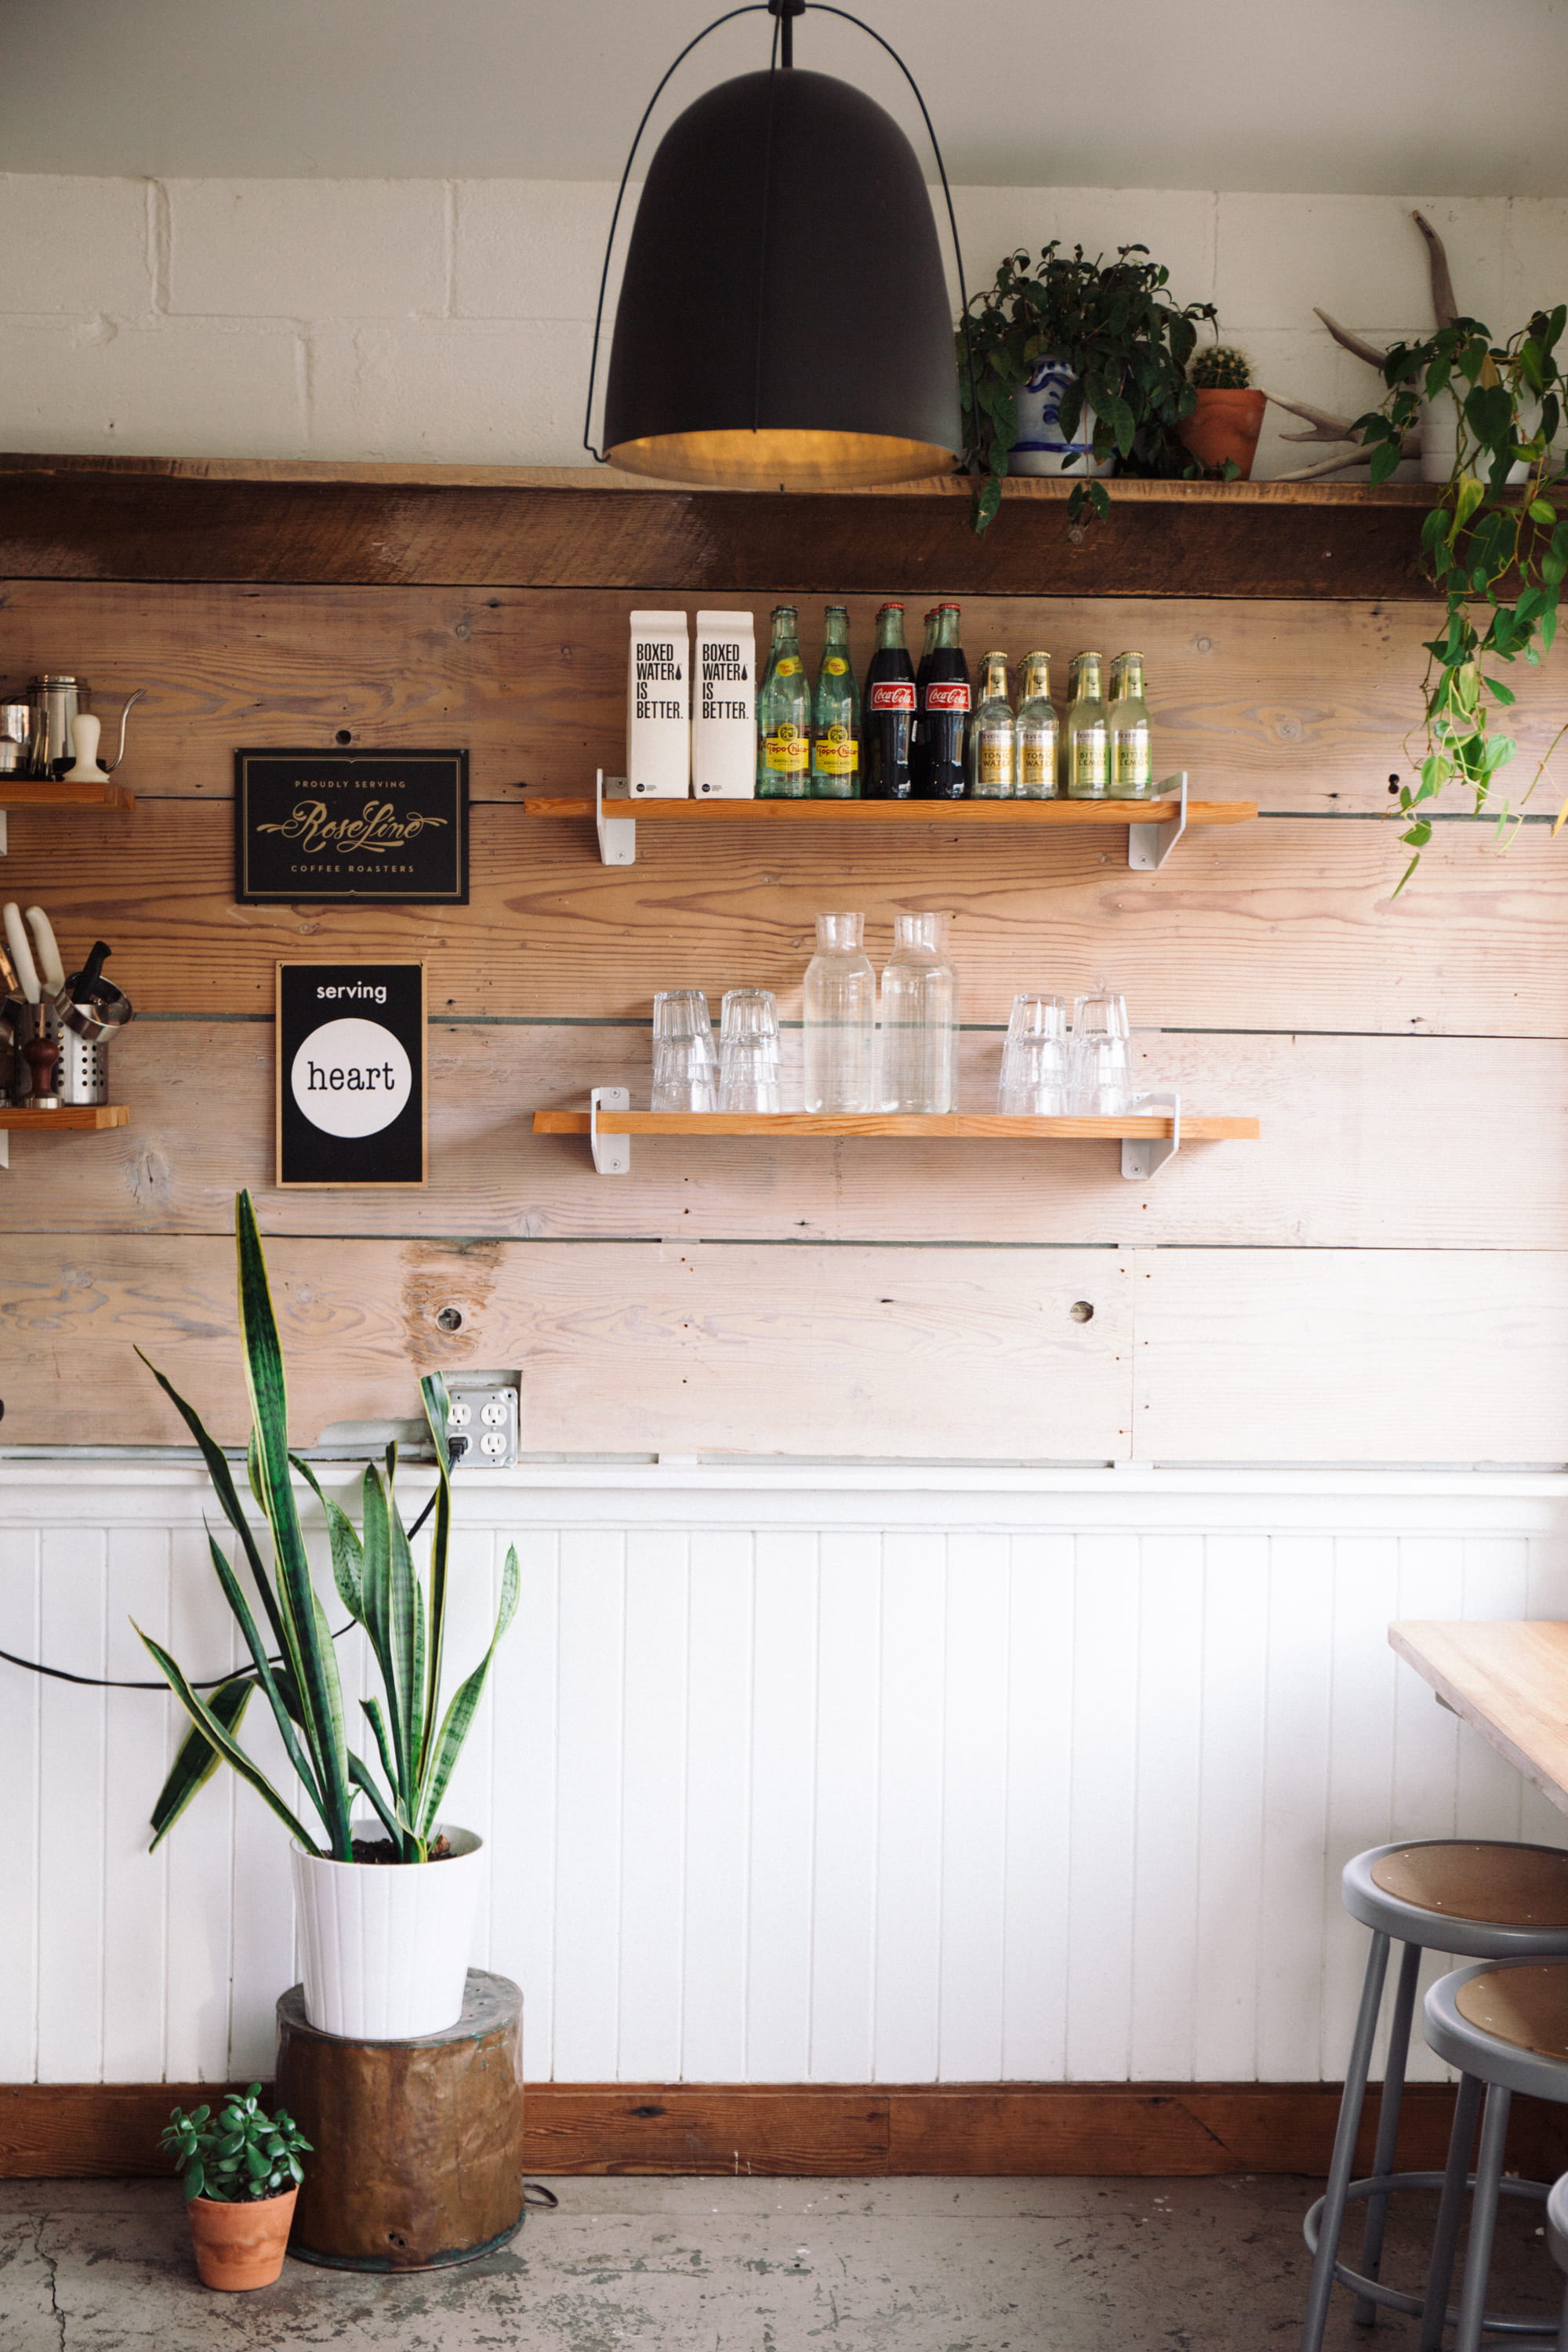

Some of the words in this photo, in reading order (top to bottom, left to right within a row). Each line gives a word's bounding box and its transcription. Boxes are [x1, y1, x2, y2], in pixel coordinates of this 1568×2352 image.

[637, 643, 673, 662] BOXED
[702, 644, 739, 662] BOXED
[637, 662, 674, 681] WATER
[702, 663, 740, 681] WATER
[637, 681, 648, 700] IS
[702, 681, 713, 700] IS
[874, 688, 912, 703] Coca-Cola
[929, 688, 966, 703] Coca-Cola
[637, 701, 684, 719] BETTER.
[702, 701, 750, 720] BETTER.
[294, 780, 348, 789] PROUDLY
[354, 780, 406, 789] SERVING
[316, 981, 387, 1004] serving
[307, 1061, 395, 1091] heart
